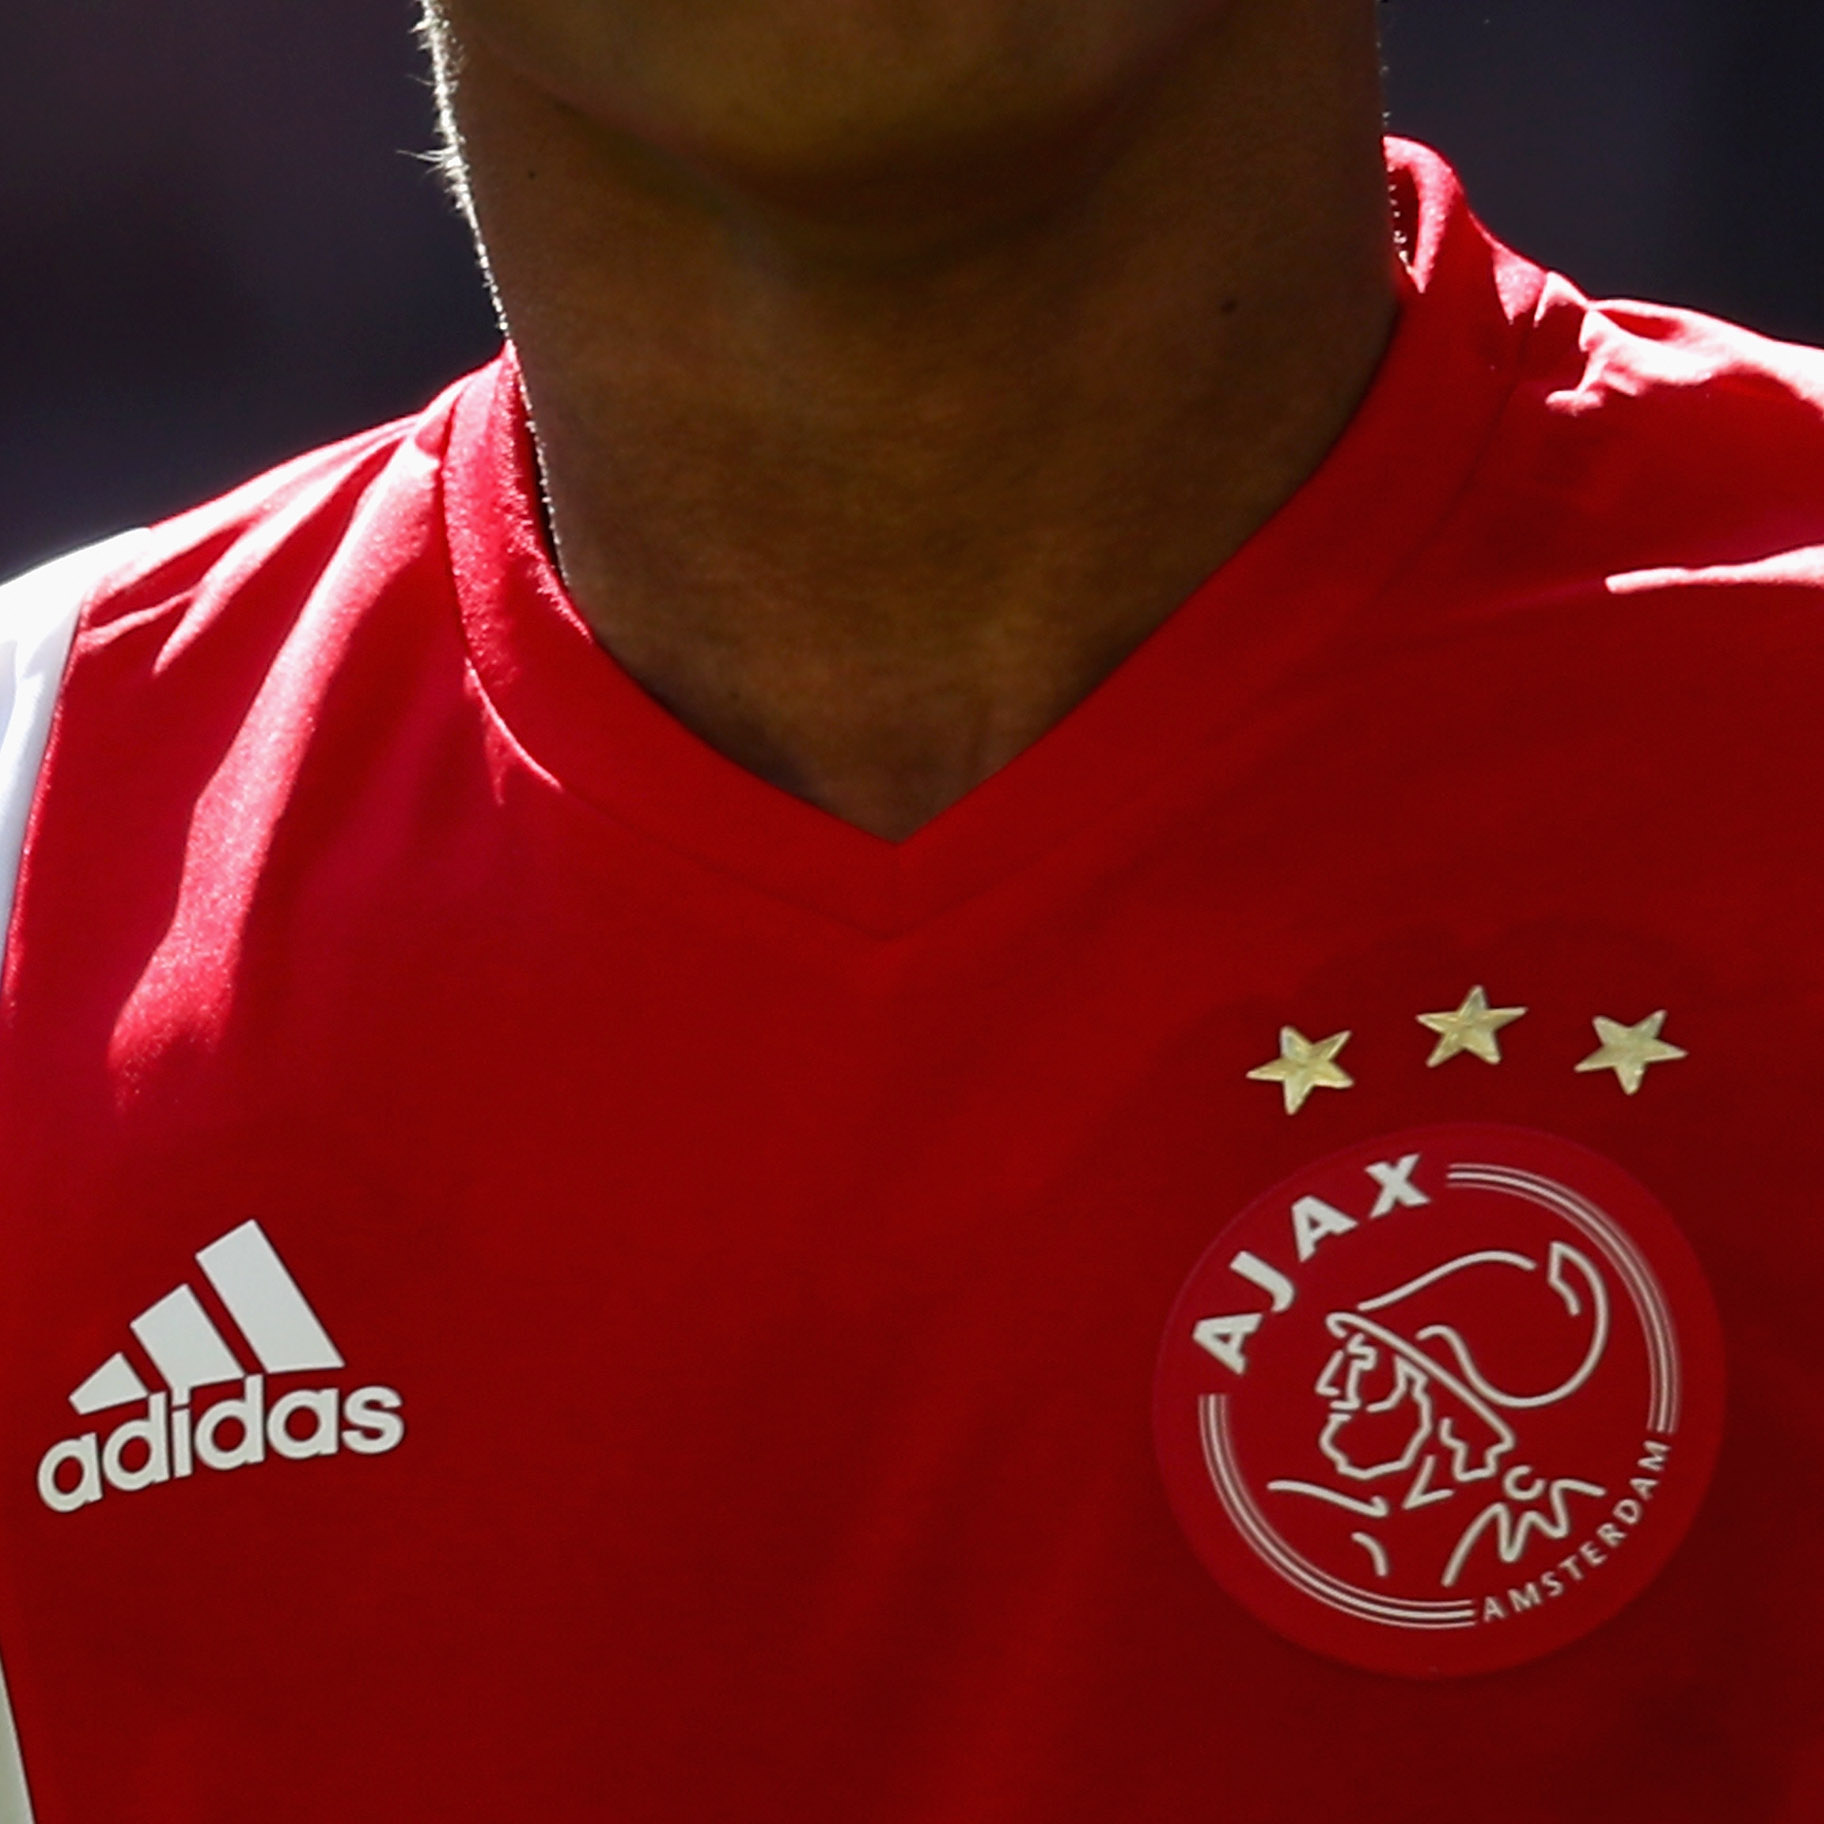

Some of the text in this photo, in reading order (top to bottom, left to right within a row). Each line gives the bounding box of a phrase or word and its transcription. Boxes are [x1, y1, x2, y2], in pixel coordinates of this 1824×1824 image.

[1193, 1153, 1431, 1374] AJAX
[37, 1374, 405, 1513] adidas
[1483, 1440, 1671, 1623] AMSTERDAM
